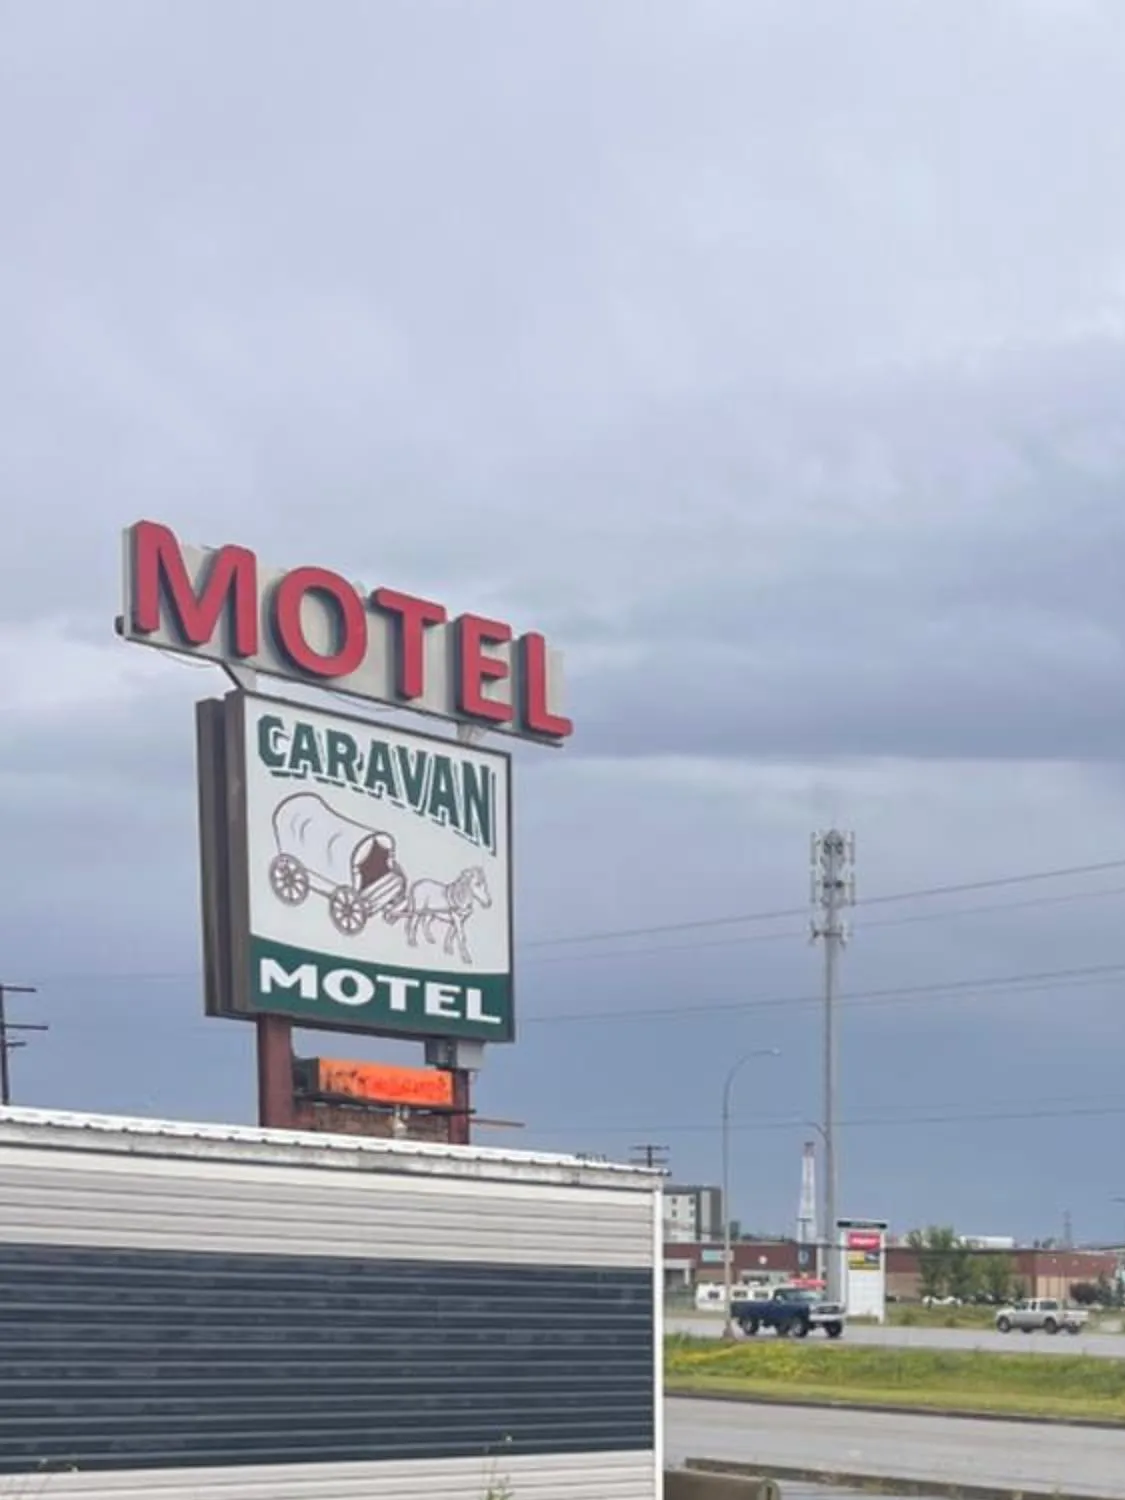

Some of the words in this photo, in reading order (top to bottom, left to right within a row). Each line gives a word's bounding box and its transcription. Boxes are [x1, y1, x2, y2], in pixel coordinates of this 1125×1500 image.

[132, 519, 573, 738] MOTEL
[257, 713, 498, 857] CARAVAN
[259, 957, 502, 1025] MOTEL
